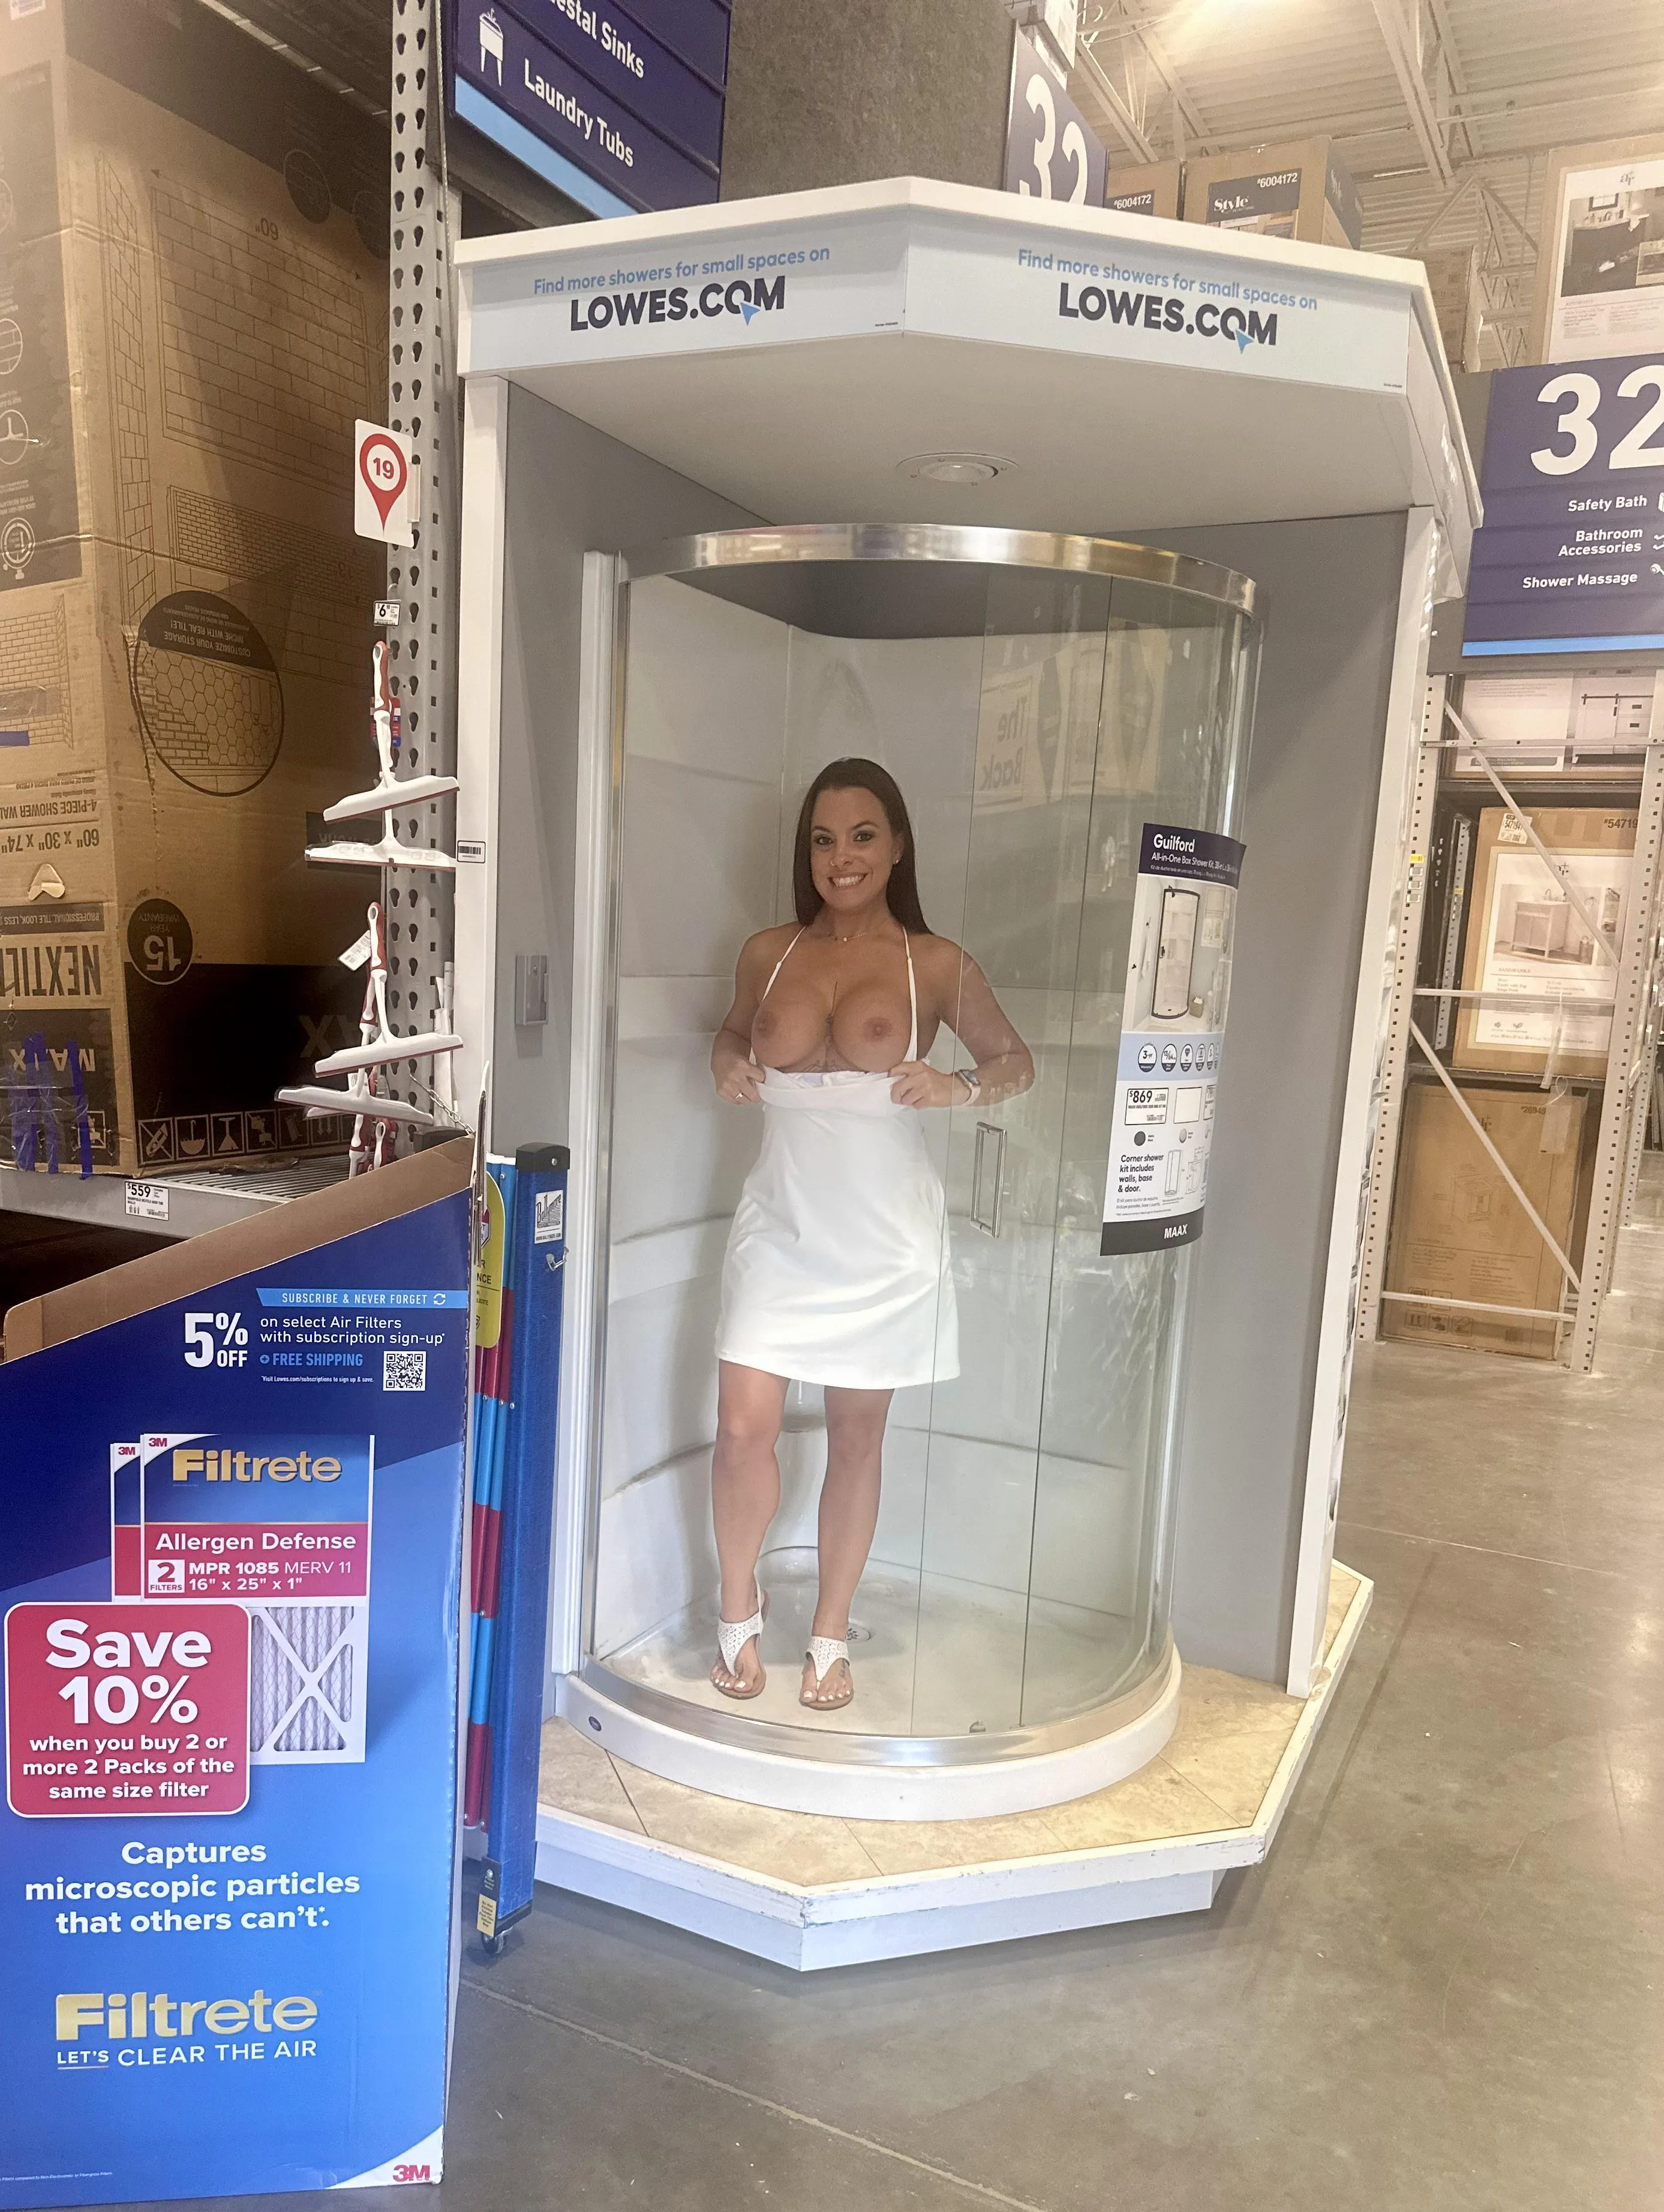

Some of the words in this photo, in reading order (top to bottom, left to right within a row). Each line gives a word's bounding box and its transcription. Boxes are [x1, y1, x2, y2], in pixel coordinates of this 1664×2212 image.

[550, 0, 597, 40] estal
[601, 21, 644, 79] Sinks
[524, 58, 594, 141] Laundry
[597, 116, 633, 167] Tubs
[1019, 74, 1088, 206] 32
[1257, 172, 1297, 188] #6004172
[1214, 196, 1248, 213] Style
[534, 277, 564, 295] Find
[567, 276, 606, 291] more
[609, 266, 672, 285] showers
[675, 262, 699, 278] for
[701, 254, 744, 274] small
[747, 251, 806, 272] spaces
[809, 247, 830, 262] on
[1018, 249, 1053, 270] Find
[1056, 260, 1099, 276] more
[1102, 263, 1170, 288] showers
[1172, 274, 1196, 291] for
[1199, 279, 1240, 298] small
[1242, 288, 1296, 307] spaces
[1299, 296, 1318, 311] on
[570, 275, 786, 331] LOWES.COM
[1059, 282, 1278, 346] LOWES.COM
[1530, 365, 1664, 476] 32
[372, 458, 395, 479] 19
[1568, 498, 1612, 512] Safety
[1615, 495, 1647, 509] Bath
[1575, 528, 1643, 542] Bathroom
[1558, 542, 1642, 557] Accessories
[1522, 576, 1574, 589] Shower
[1577, 572, 1638, 587] Massage
[188, 623, 206, 635] REAL
[207, 628, 224, 640] WITH
[163, 631, 195, 645] STORAGE
[196, 638, 214, 649] YOUR
[215, 642, 251, 657] CUSTOMIZE
[20, 802, 59, 817] SHOWER
[60, 801, 97, 815] 4-PIECE
[38, 832, 61, 850] 30"
[77, 828, 100, 847] 60"
[1154, 834, 1195, 853] Guilford
[1151, 852, 1181, 863] All-in-One
[4, 915, 19, 925] LESS
[38, 914, 52, 924] TILE
[53, 912, 100, 923] PROFESSIONAL
[138, 913, 181, 923] WARRANTY
[144, 935, 181, 971] 15
[1130, 1090, 1152, 1103] $869
[127, 1183, 151, 1198] $559
[1164, 1224, 1188, 1239] MAAX
[282, 1293, 338, 1303] SUBSCRIBE
[343, 1294, 350, 1303] &
[354, 1294, 386, 1304] NEVER
[390, 1294, 428, 1305] FORGET
[260, 1317, 278, 1328] on
[283, 1316, 326, 1328] select
[330, 1317, 352, 1329] Air
[356, 1317, 402, 1329] Filters
[184, 1312, 248, 1368] 5%
[260, 1331, 291, 1343] with
[296, 1331, 385, 1345] subscription
[217, 1350, 248, 1368] OFF
[273, 1353, 302, 1366] FREE
[307, 1353, 363, 1366] SHIPPING
[118, 1446, 136, 1456] 3M
[148, 1437, 168, 1448] 3M
[172, 1449, 343, 1483] Filtrete
[155, 1532, 254, 1555] Allergen
[262, 1532, 357, 1550] Defense
[157, 1562, 176, 1583] 2
[189, 1562, 230, 1575] MPR
[235, 1562, 280, 1574] 1085
[284, 1561, 335, 1574] MERV
[338, 1561, 352, 1573] 11
[189, 1577, 216, 1591] 16"
[221, 1580, 231, 1591] x
[237, 1577, 266, 1590] 25"
[272, 1580, 281, 1589] x
[288, 1577, 302, 1589] 1"
[45, 1618, 212, 1669] Save
[58, 1674, 198, 1724] 10%
[29, 1735, 89, 1752] when
[94, 1736, 134, 1754] you
[140, 1734, 180, 1754] buy
[185, 1733, 199, 1749] 2
[205, 1736, 227, 1750] or
[23, 1761, 79, 1775] more
[84, 1759, 98, 1775] 2
[104, 1757, 167, 1774] Packs
[173, 1757, 196, 1774] of
[200, 1756, 235, 1772] the
[49, 1785, 106, 1800] same
[112, 1781, 154, 1798] size
[158, 1781, 209, 1798] filter
[121, 1841, 267, 1870] Captures
[25, 1873, 218, 1903] microscopic
[226, 1872, 360, 1901] particles
[56, 1911, 122, 1934] that
[130, 1909, 233, 1932] others
[56, 1989, 318, 2042] Filtrete
[57, 2049, 109, 2064] LET'S
[118, 2045, 205, 2067] CLEAR
[215, 2044, 265, 2061] THE
[274, 2040, 317, 2058] AIR
[393, 2165, 430, 2181] 3M
